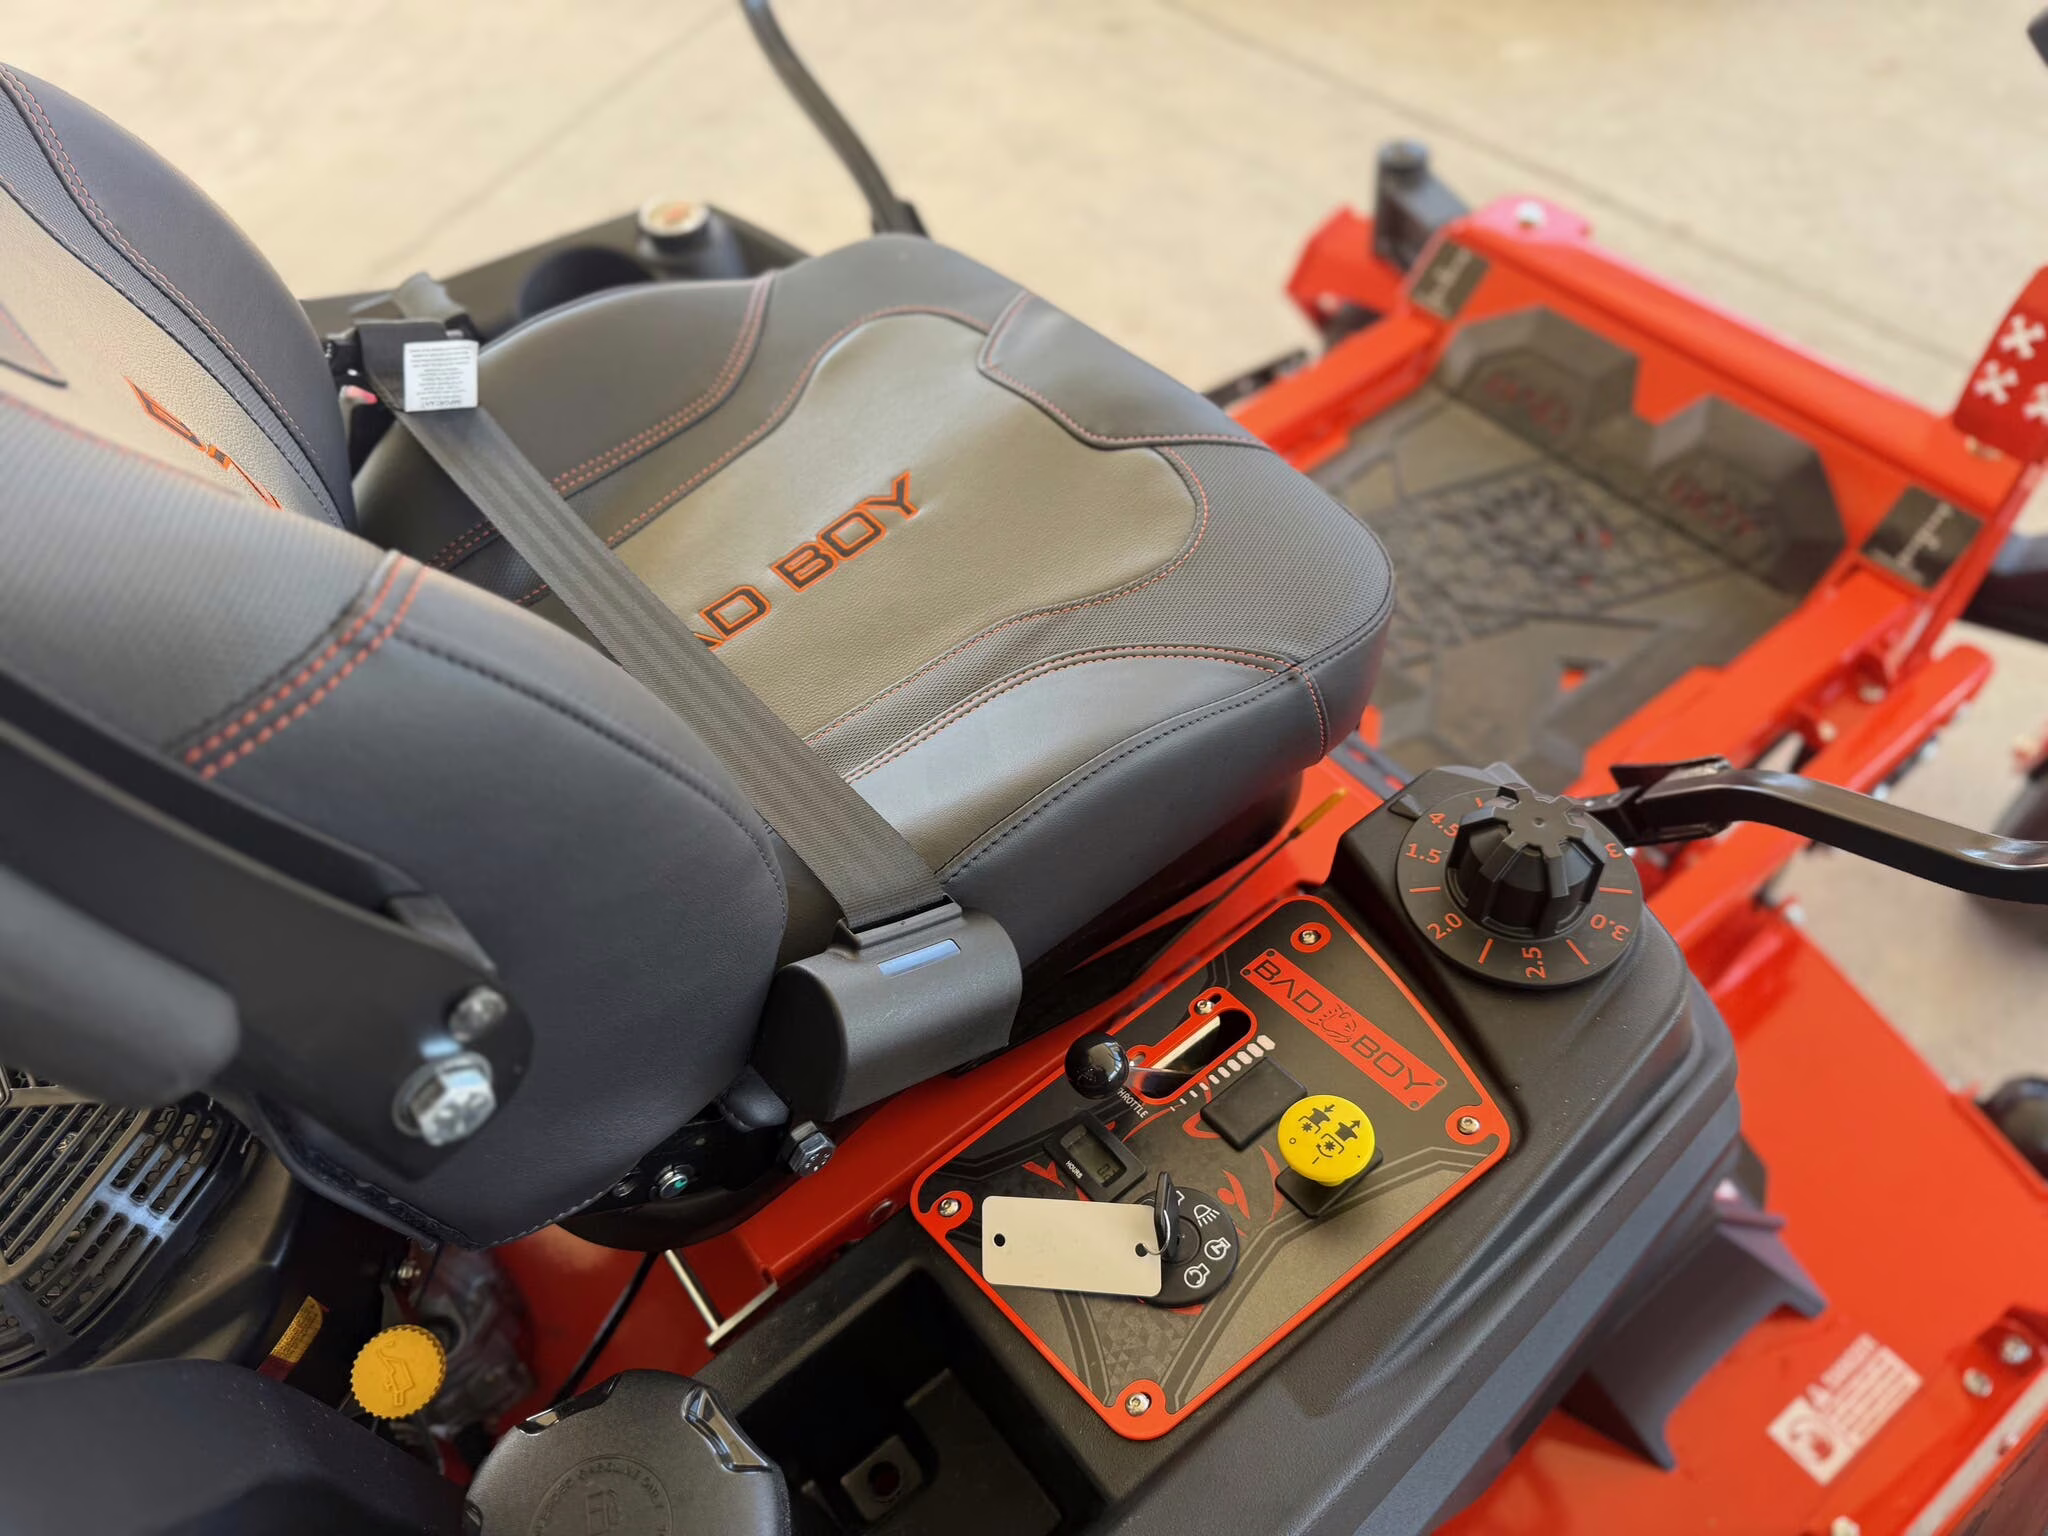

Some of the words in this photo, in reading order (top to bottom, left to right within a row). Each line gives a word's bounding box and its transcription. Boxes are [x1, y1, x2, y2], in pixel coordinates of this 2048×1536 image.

[769, 469, 919, 593] BOY
[1428, 812, 1460, 839] 4.5
[1405, 842, 1442, 864] 1.5
[1426, 912, 1463, 940] 2.0
[1589, 913, 1630, 942] 3.0
[1521, 946, 1546, 979] 2.5
[1253, 959, 1323, 1014] BAD
[1350, 1034, 1433, 1091] BOY
[1065, 1159, 1083, 1179] HOURS
